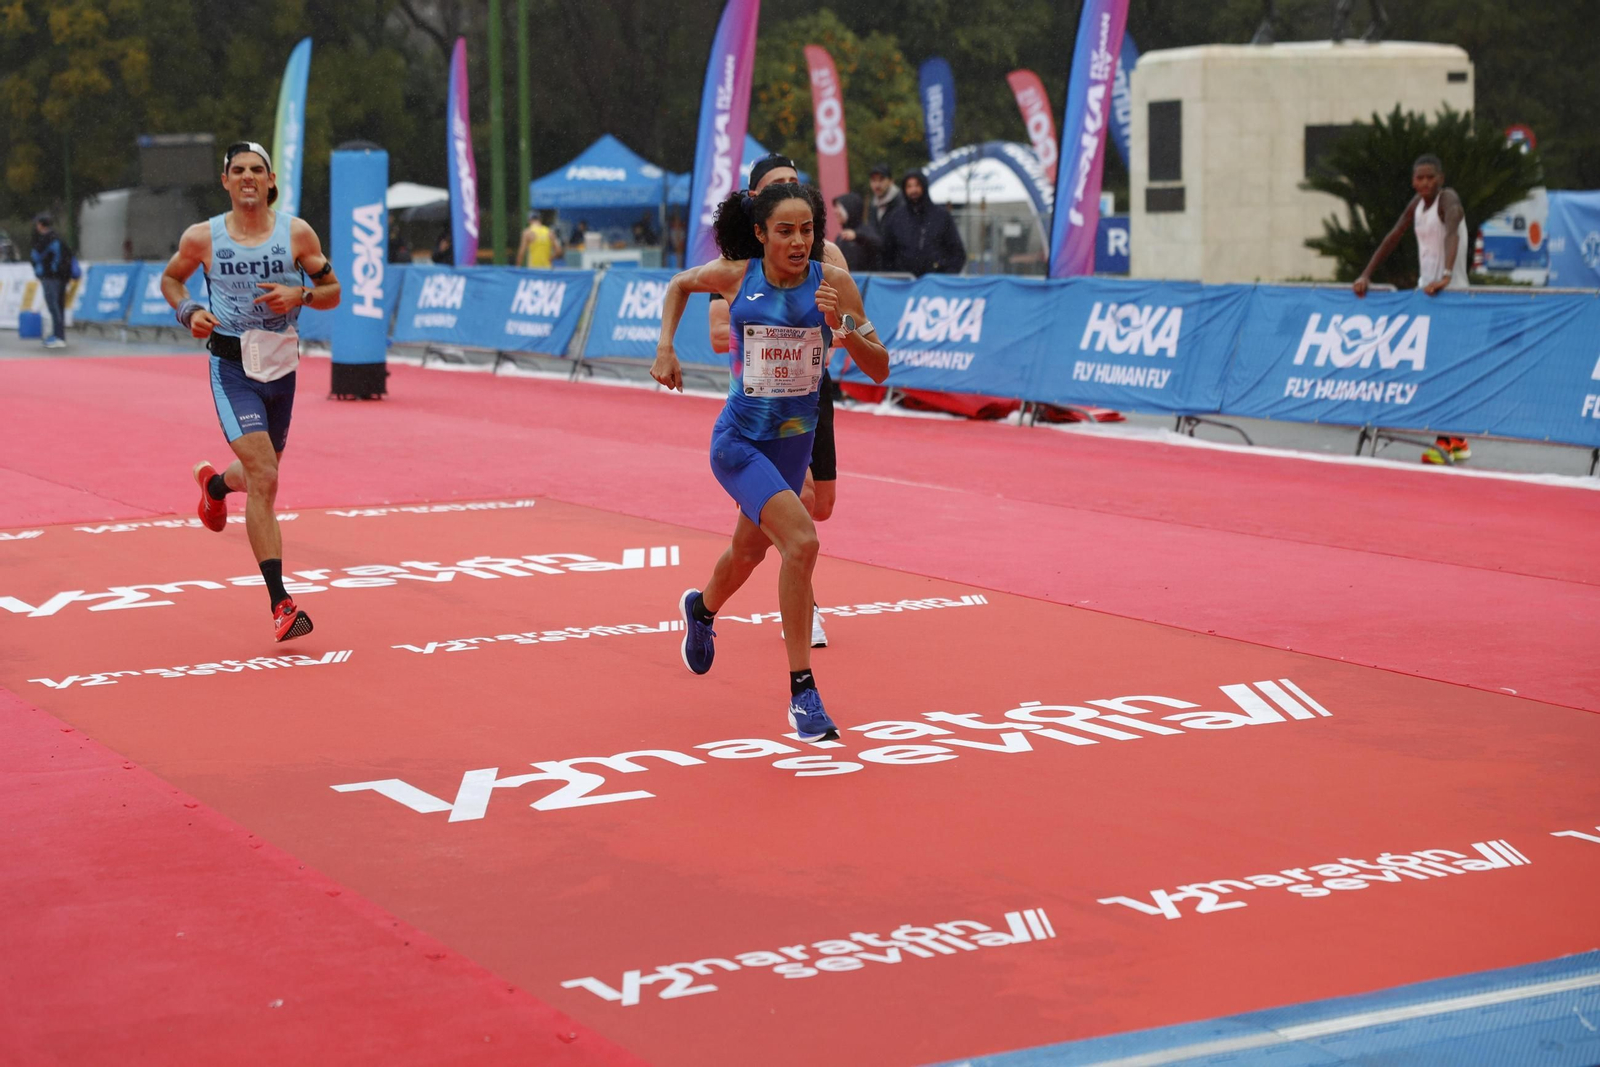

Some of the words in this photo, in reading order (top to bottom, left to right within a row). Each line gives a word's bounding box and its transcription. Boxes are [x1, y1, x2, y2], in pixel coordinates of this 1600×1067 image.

[1107, 227, 1131, 256] R
[218, 255, 285, 280] nerja
[351, 201, 385, 320] HOKA
[416, 273, 467, 310] HOKA
[510, 278, 567, 318] HOKA
[617, 280, 669, 320] HOK
[896, 295, 986, 344] HOKA
[1079, 301, 1183, 358] HOKA
[761, 348, 802, 361] IKRAM
[904, 348, 951, 370] HUMAN
[948, 351, 976, 371] FLY
[1293, 313, 1431, 371] HOKA
[774, 366, 789, 378] 59
[1072, 360, 1096, 381] FLY
[1094, 363, 1148, 388] HUMAN
[1145, 367, 1172, 390] FLY
[1283, 377, 1315, 399] FLY
[1313, 378, 1385, 403] HUMAN
[1384, 382, 1419, 405] FLY
[1581, 393, 1600, 420] FL
[1176, 848, 1469, 894] maratón
[655, 919, 993, 975] maratón
